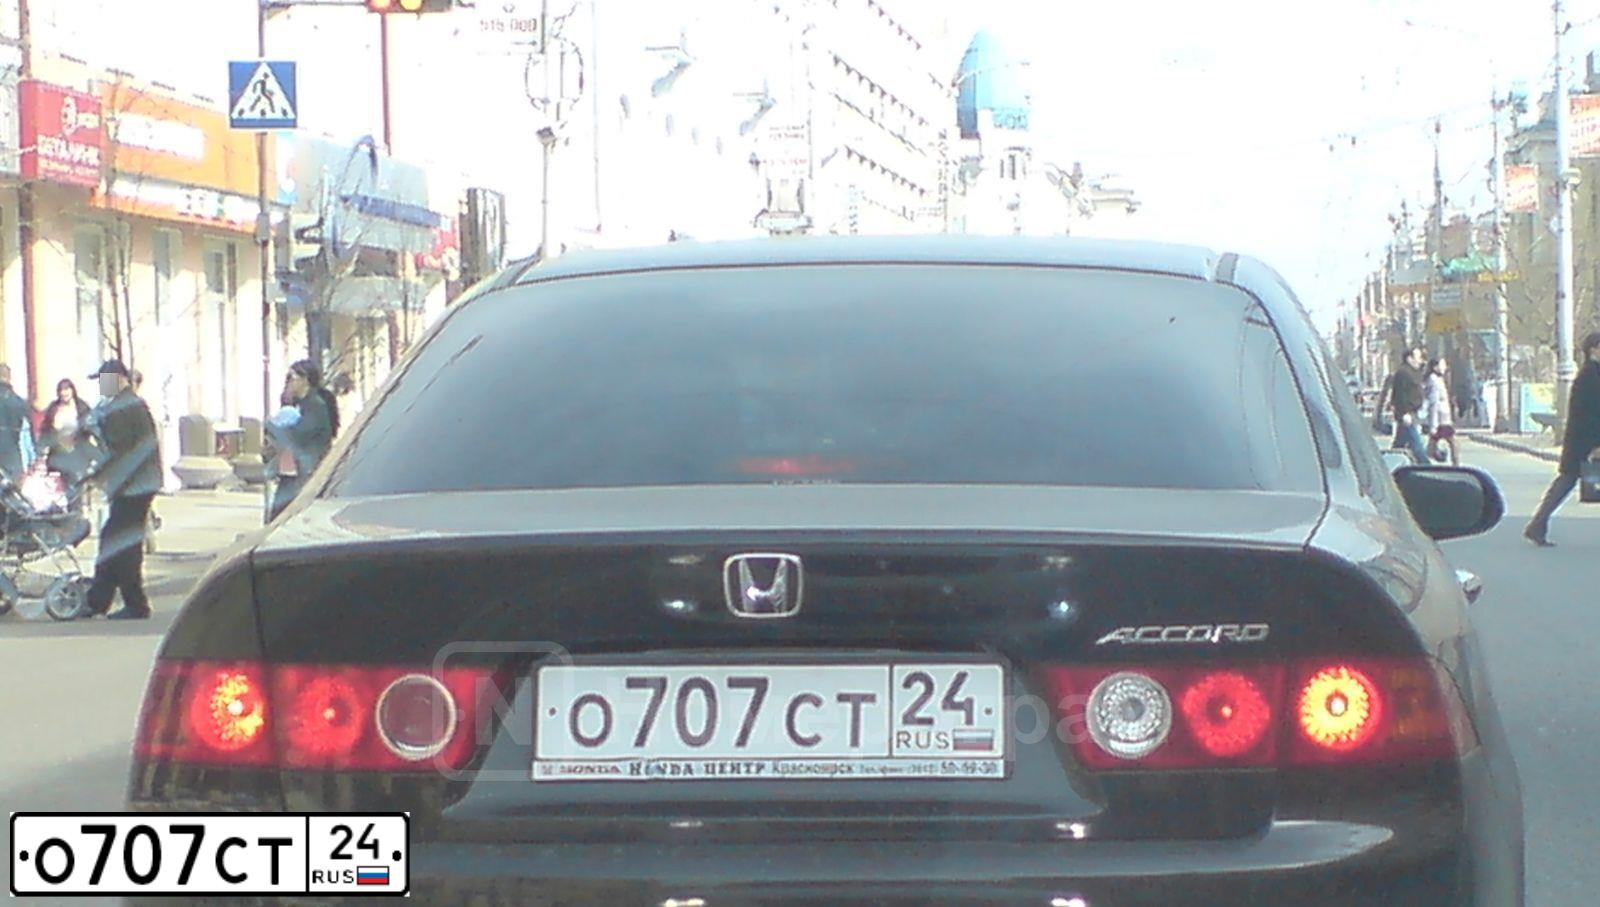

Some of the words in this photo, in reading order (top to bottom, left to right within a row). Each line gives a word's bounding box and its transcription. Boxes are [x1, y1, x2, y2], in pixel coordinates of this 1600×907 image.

[1096, 623, 1269, 645] ACCORD
[901, 671, 974, 726] 24
[896, 731, 949, 750] RUS
[705, 762, 765, 775] ЦЕНТР
